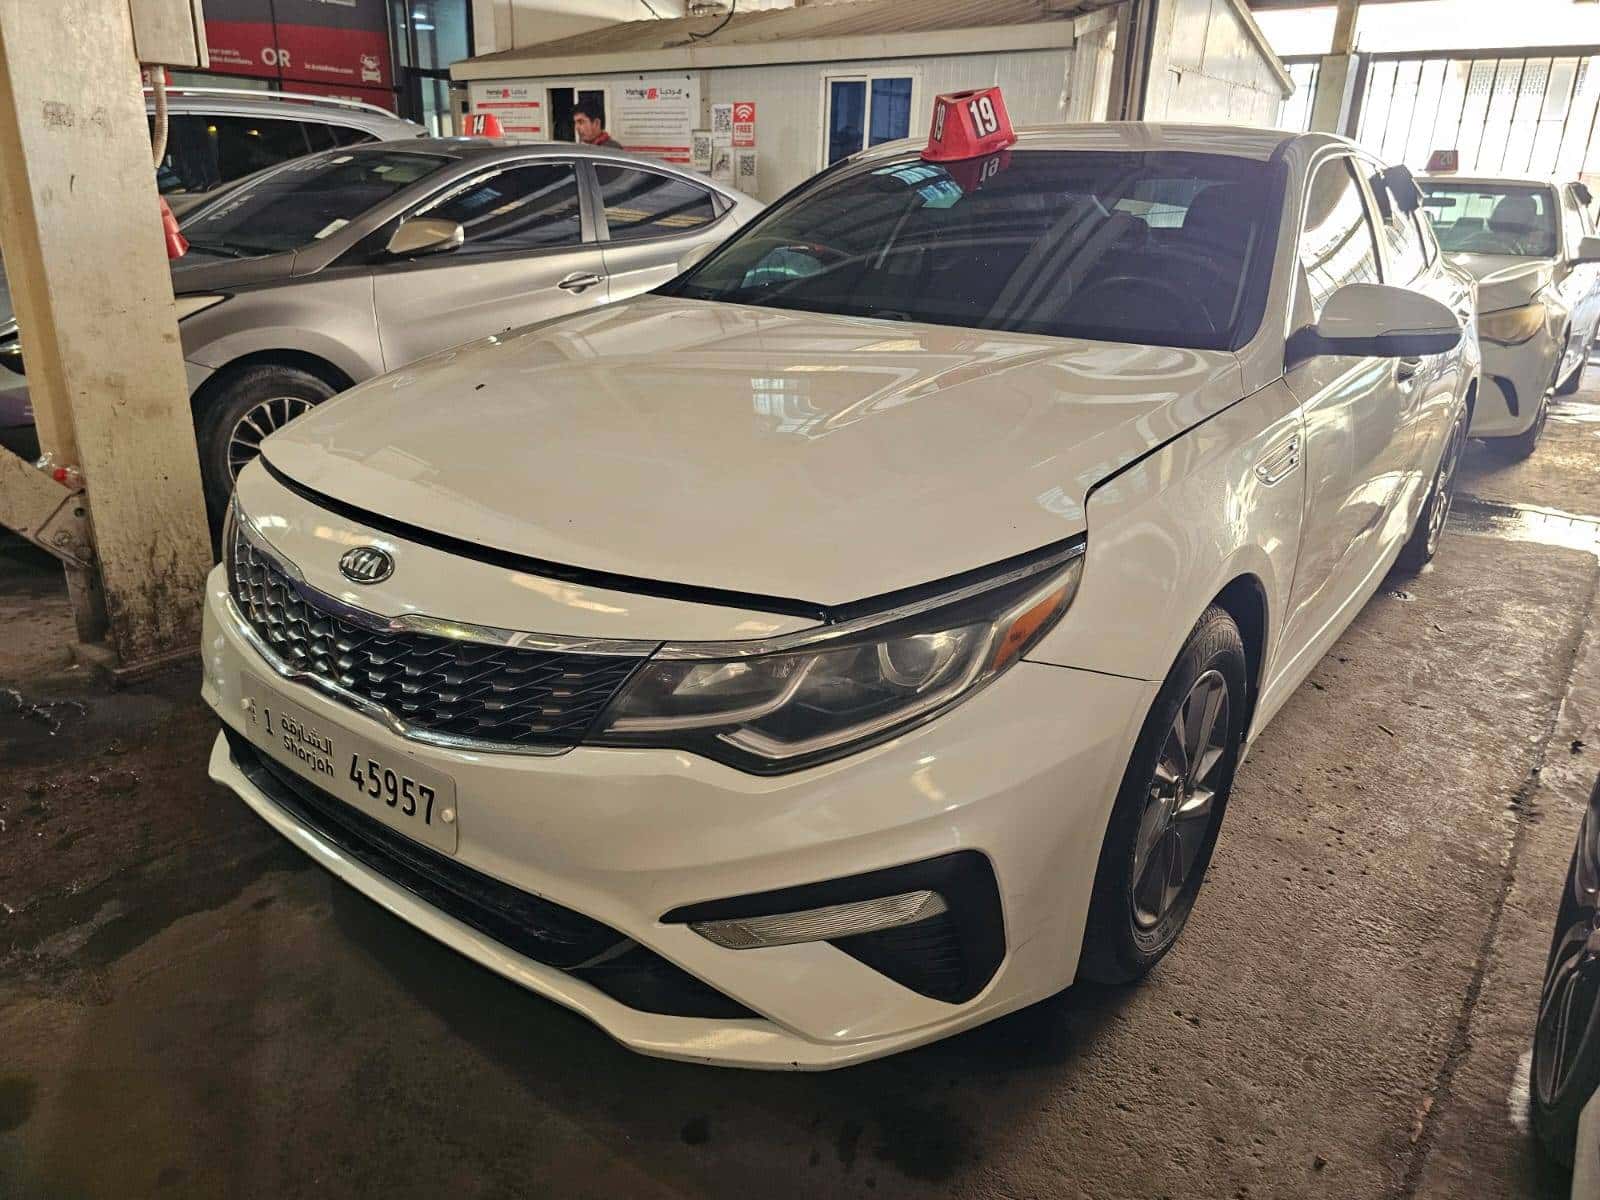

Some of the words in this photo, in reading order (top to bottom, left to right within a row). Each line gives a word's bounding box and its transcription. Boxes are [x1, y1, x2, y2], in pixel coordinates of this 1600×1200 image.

[261, 47, 291, 68] OR
[970, 96, 997, 137] 19
[264, 708, 275, 736] 1
[281, 712, 333, 757] الشارقة
[284, 735, 334, 777] Sharjah
[349, 752, 436, 825] 45957
